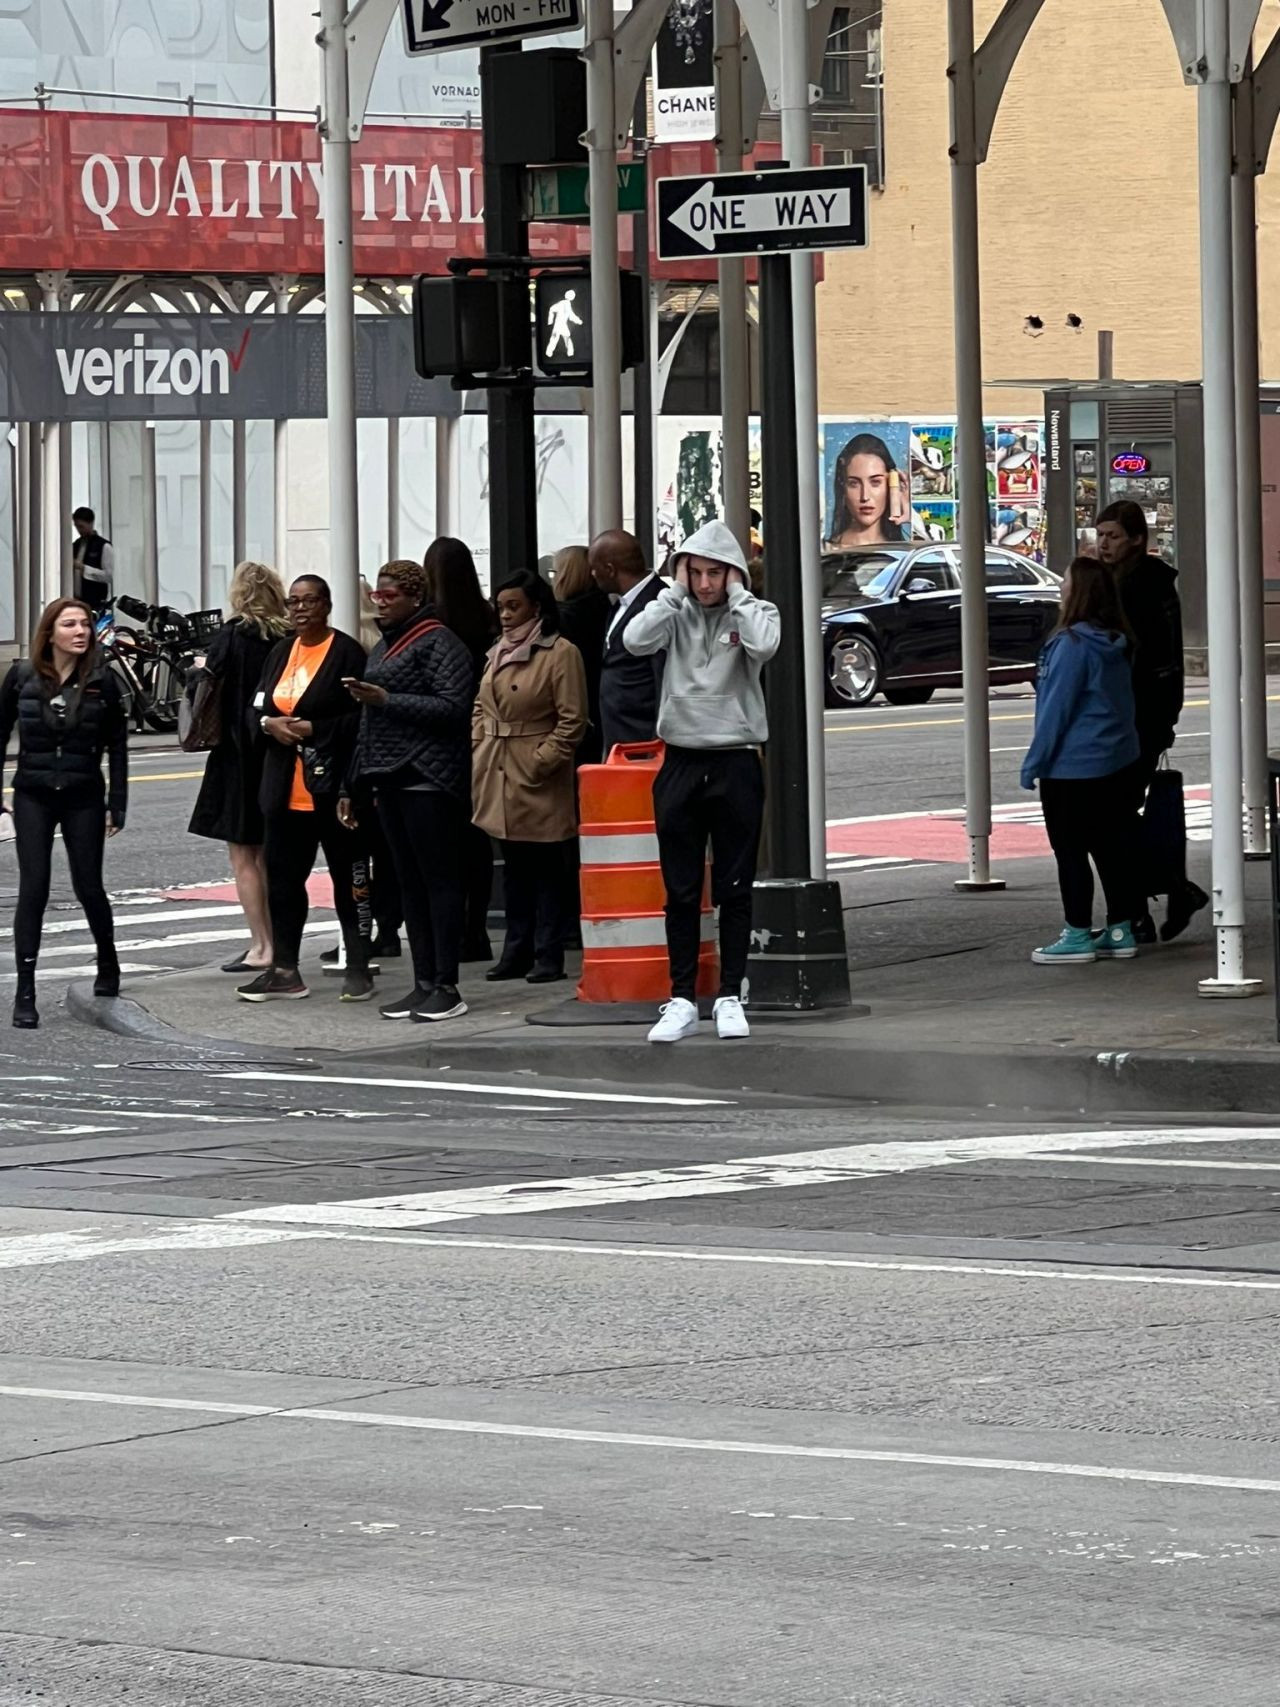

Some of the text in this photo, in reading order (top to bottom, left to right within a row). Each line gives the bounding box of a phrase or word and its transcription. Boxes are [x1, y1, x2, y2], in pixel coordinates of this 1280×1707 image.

[477, 3, 515, 26] MON
[538, 0, 567, 16] FRI
[689, 193, 838, 231] ONE WAY
[55, 333, 230, 396] verizon
[1050, 410, 1061, 470] Newsstand
[1113, 458, 1146, 470] OPEN
